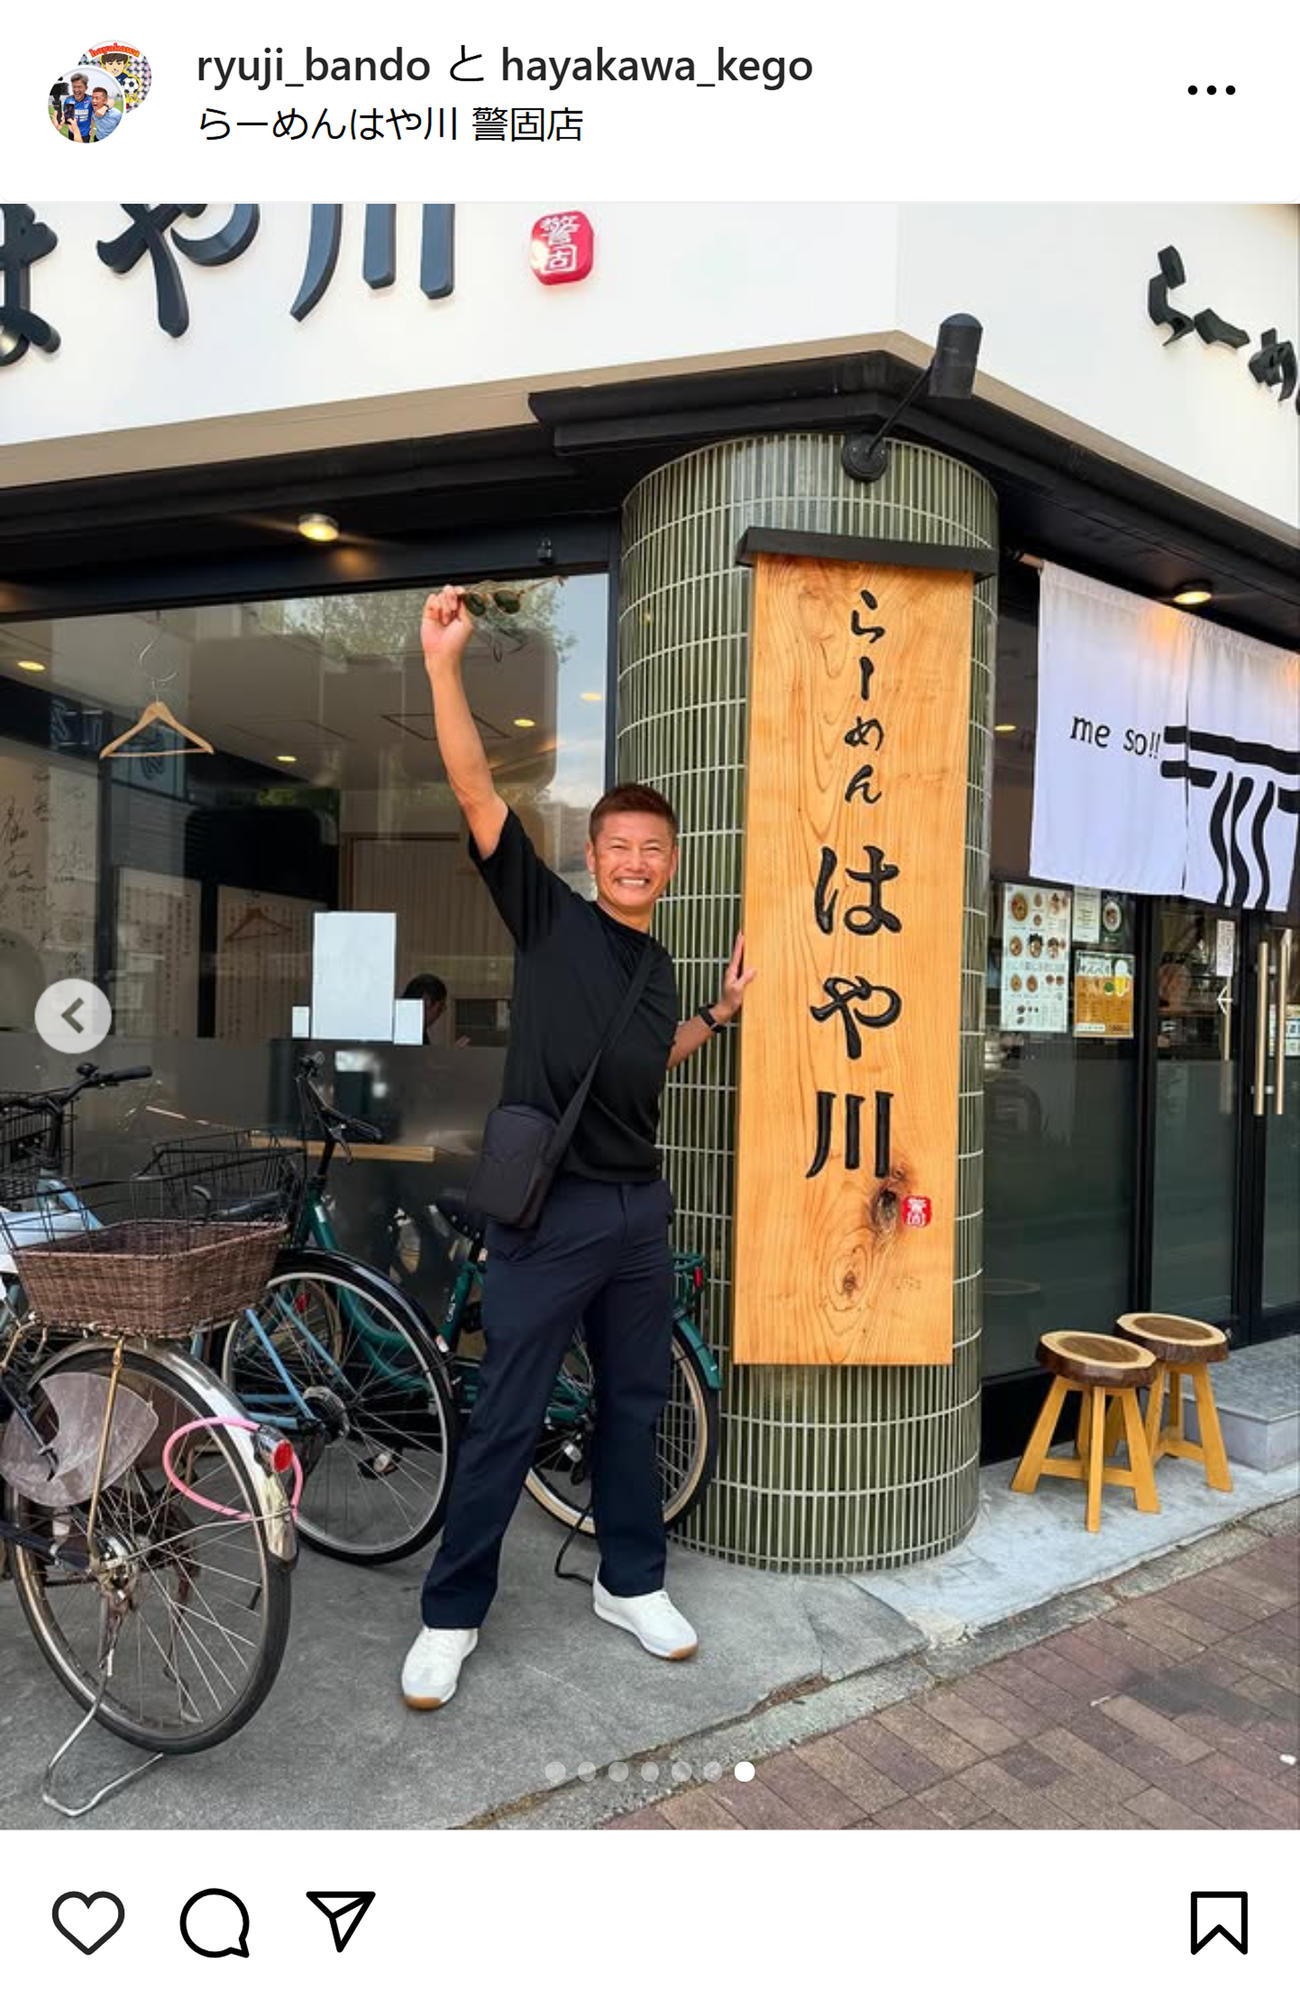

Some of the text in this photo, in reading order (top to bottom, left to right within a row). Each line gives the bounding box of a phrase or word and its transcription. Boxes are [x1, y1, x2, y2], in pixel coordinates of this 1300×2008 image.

[1148, 245, 1299, 416] らーめ
[1069, 716, 1161, 760] me so!!
[805, 590, 903, 1178] らーめん はや川
